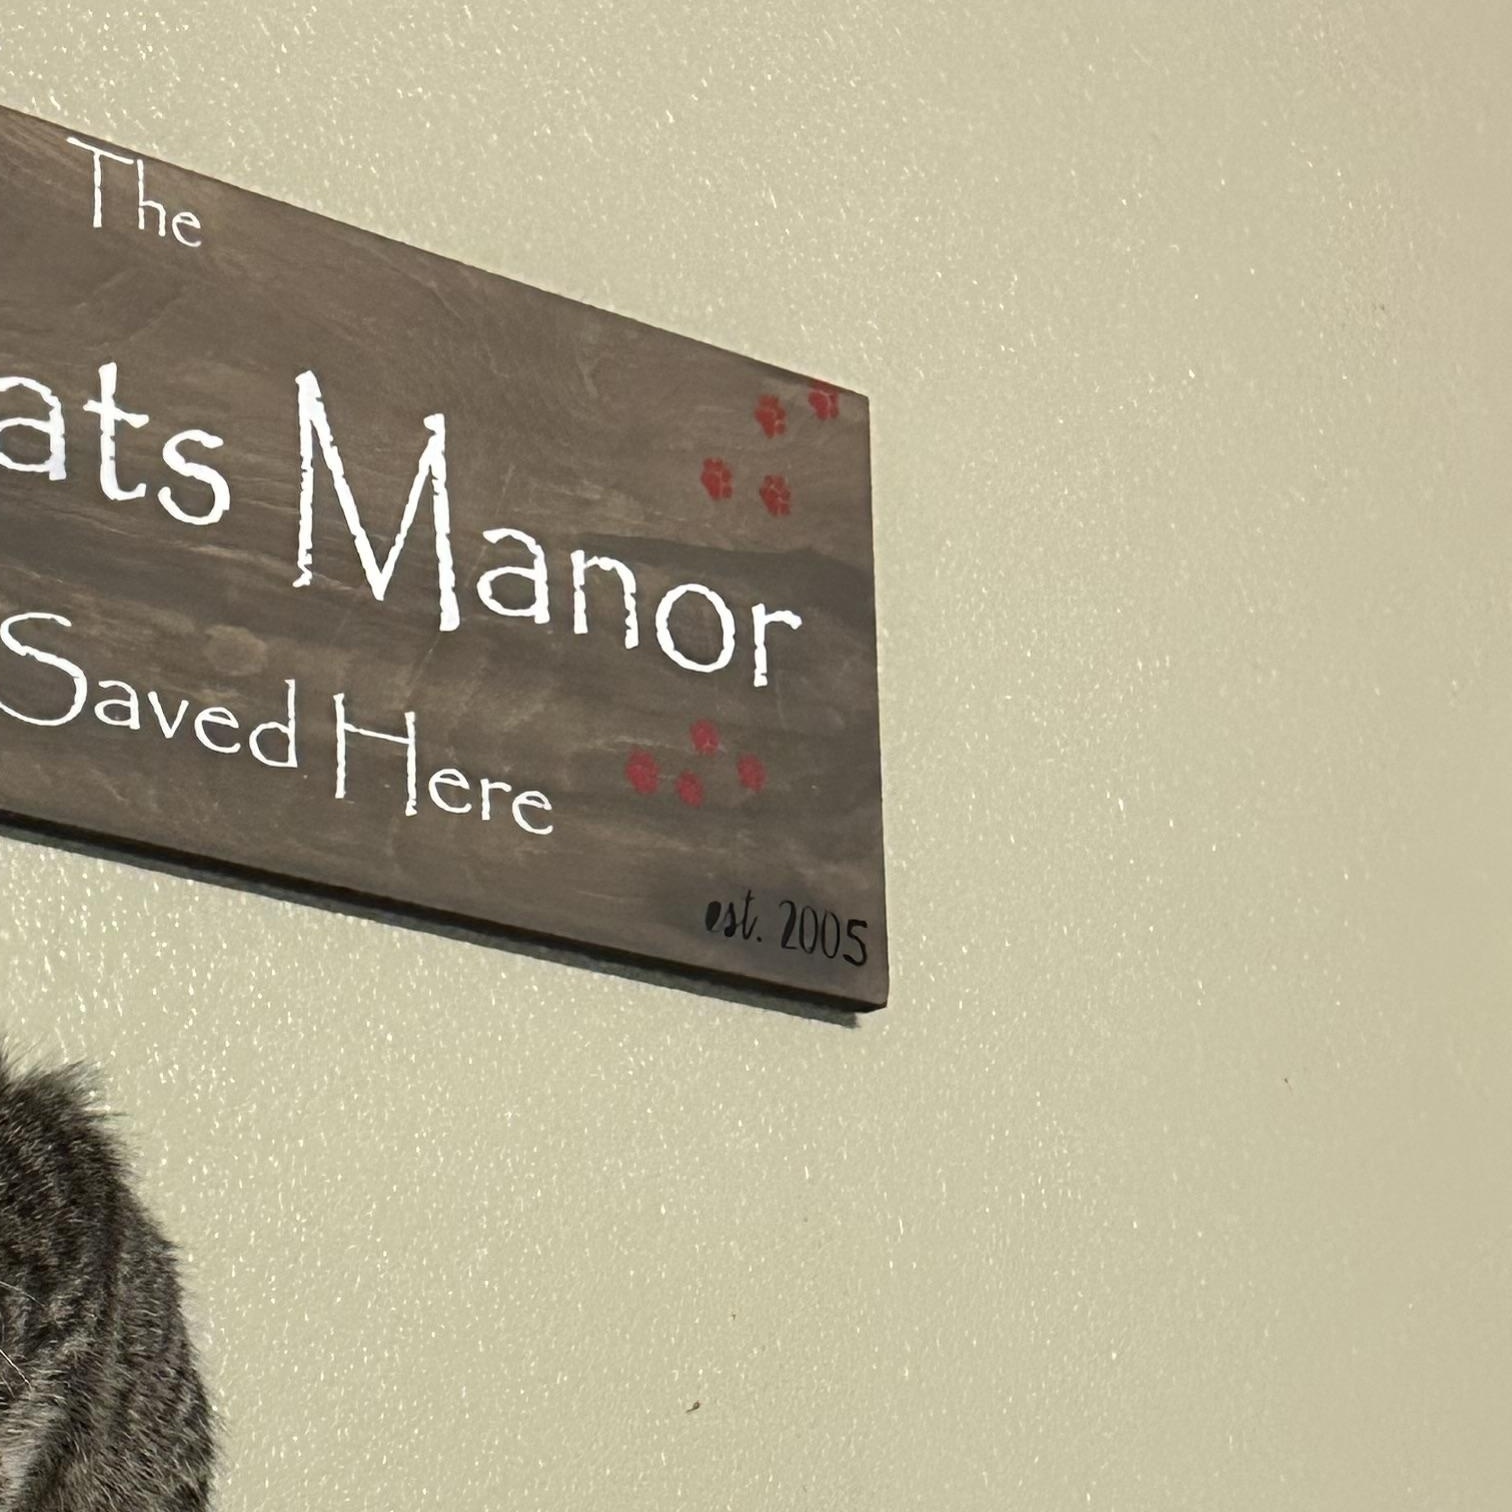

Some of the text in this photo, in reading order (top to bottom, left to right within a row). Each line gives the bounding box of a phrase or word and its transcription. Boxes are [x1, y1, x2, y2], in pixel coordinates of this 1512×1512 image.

[66, 136, 203, 247] The
[292, 370, 803, 688] Manor
[332, 692, 554, 835] Here
[704, 889, 869, 967] est. 2005
